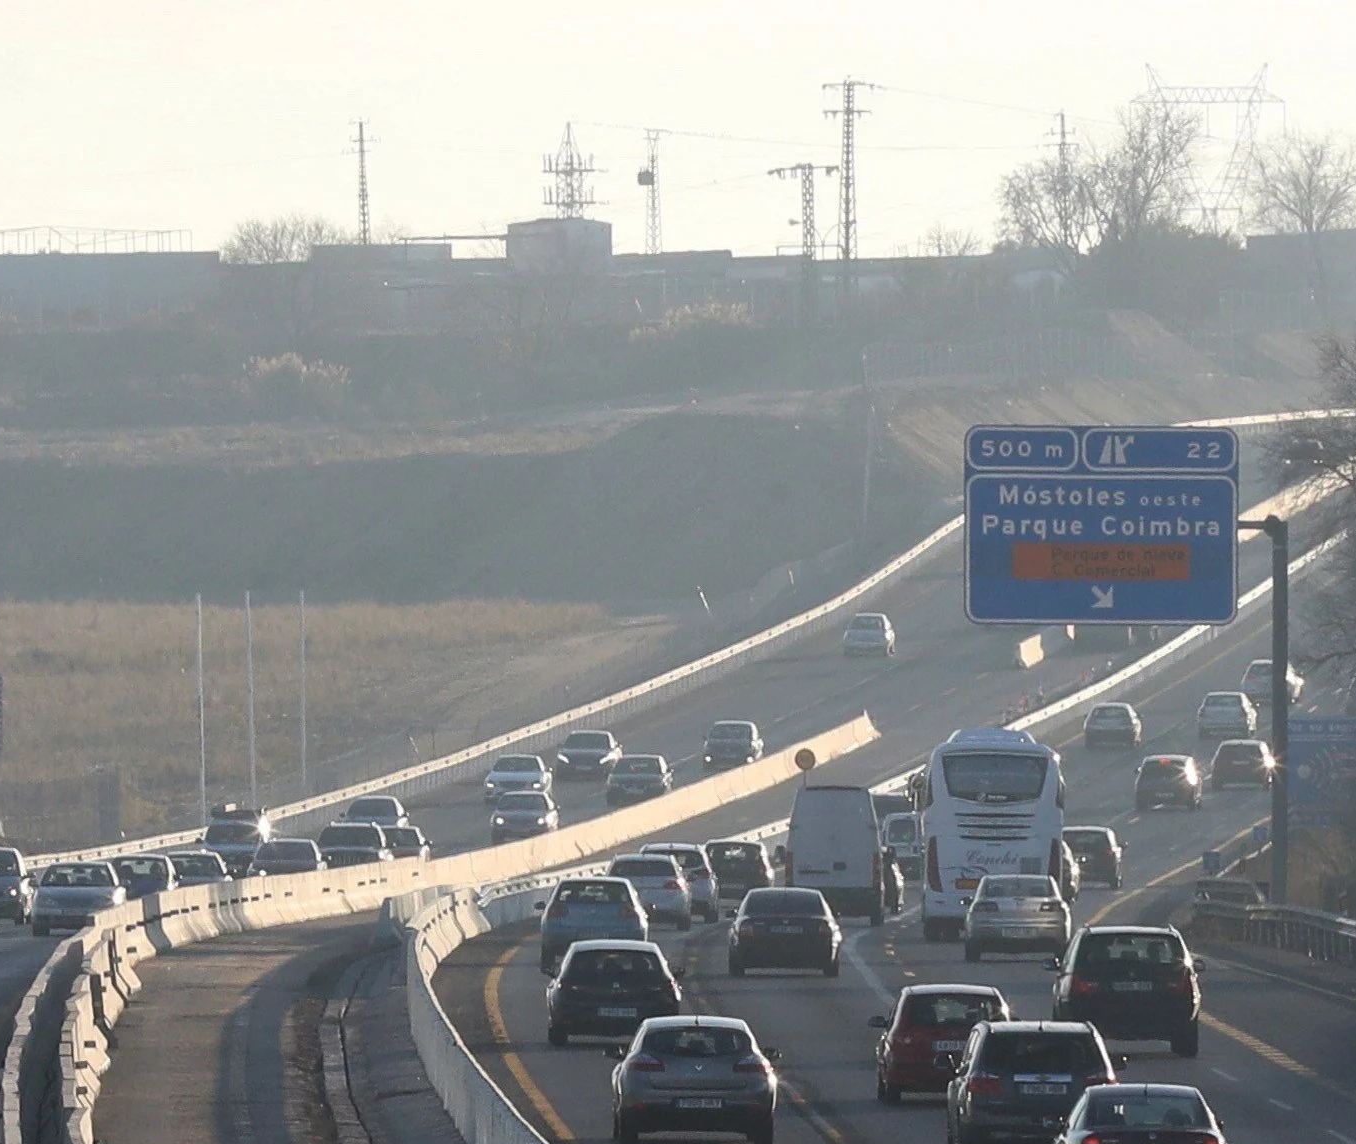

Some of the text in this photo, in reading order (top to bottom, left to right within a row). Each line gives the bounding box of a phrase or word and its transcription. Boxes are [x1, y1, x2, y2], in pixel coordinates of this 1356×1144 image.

[981, 440, 1063, 458] 500 m
[1187, 442, 1221, 459] 22
[999, 484, 1202, 507] Móstoles oeste
[981, 514, 1221, 540] Parque Coimbra
